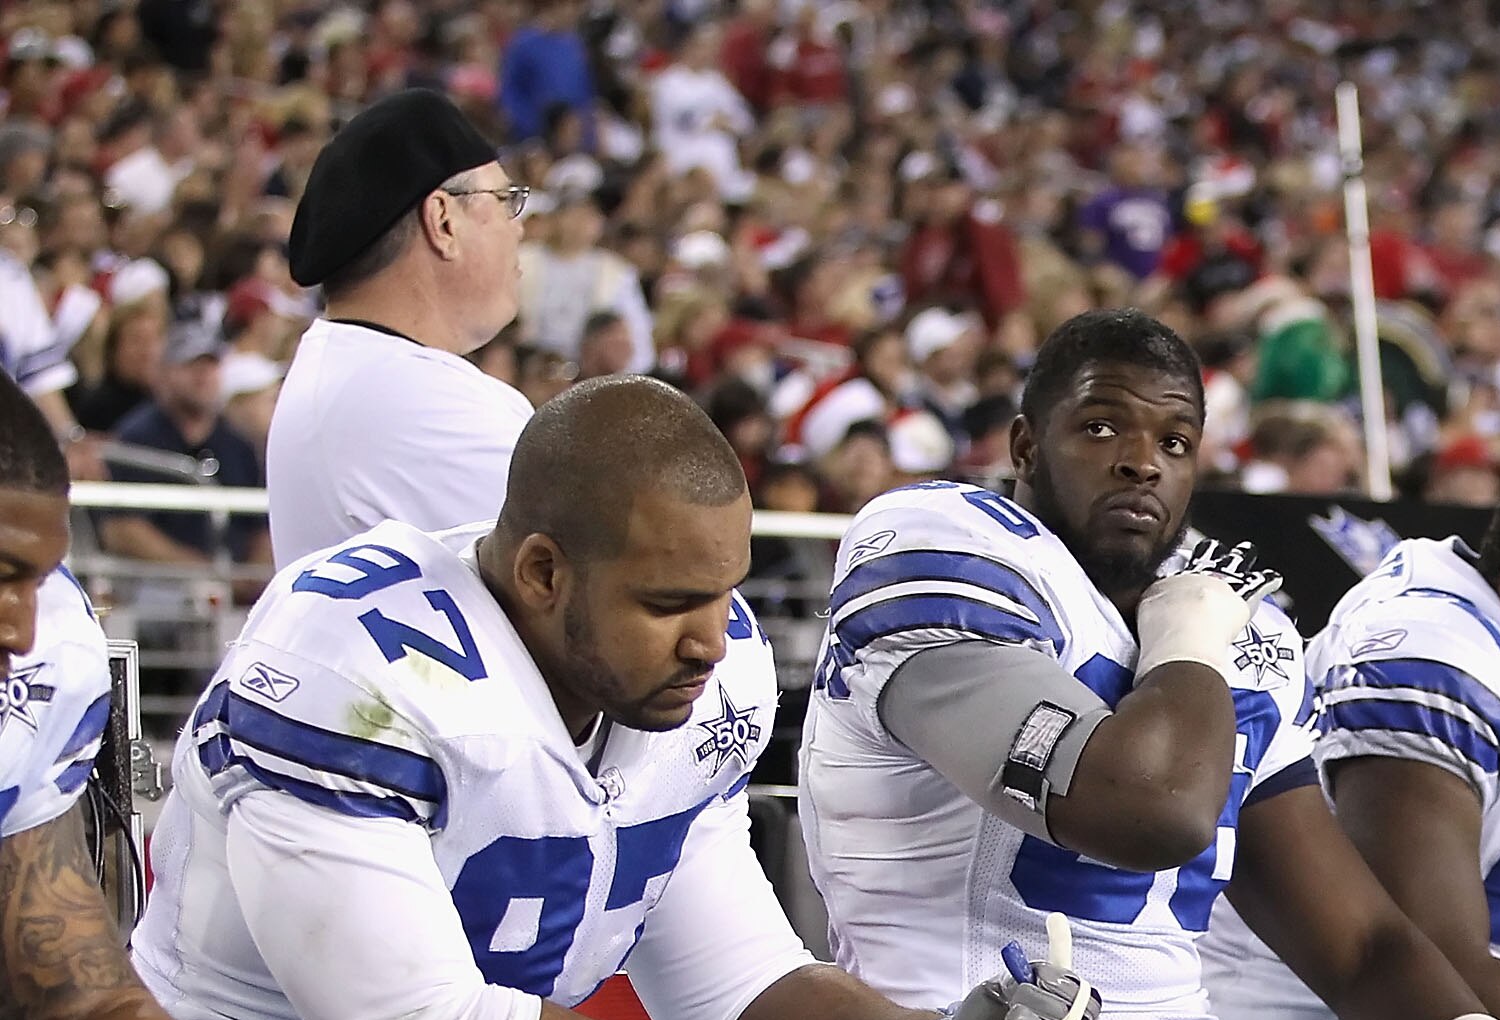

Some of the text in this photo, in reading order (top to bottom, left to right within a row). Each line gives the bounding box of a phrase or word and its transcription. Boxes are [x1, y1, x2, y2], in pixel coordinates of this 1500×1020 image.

[290, 544, 488, 682] 97
[1244, 641, 1279, 666] 50
[716, 718, 750, 749] 50
